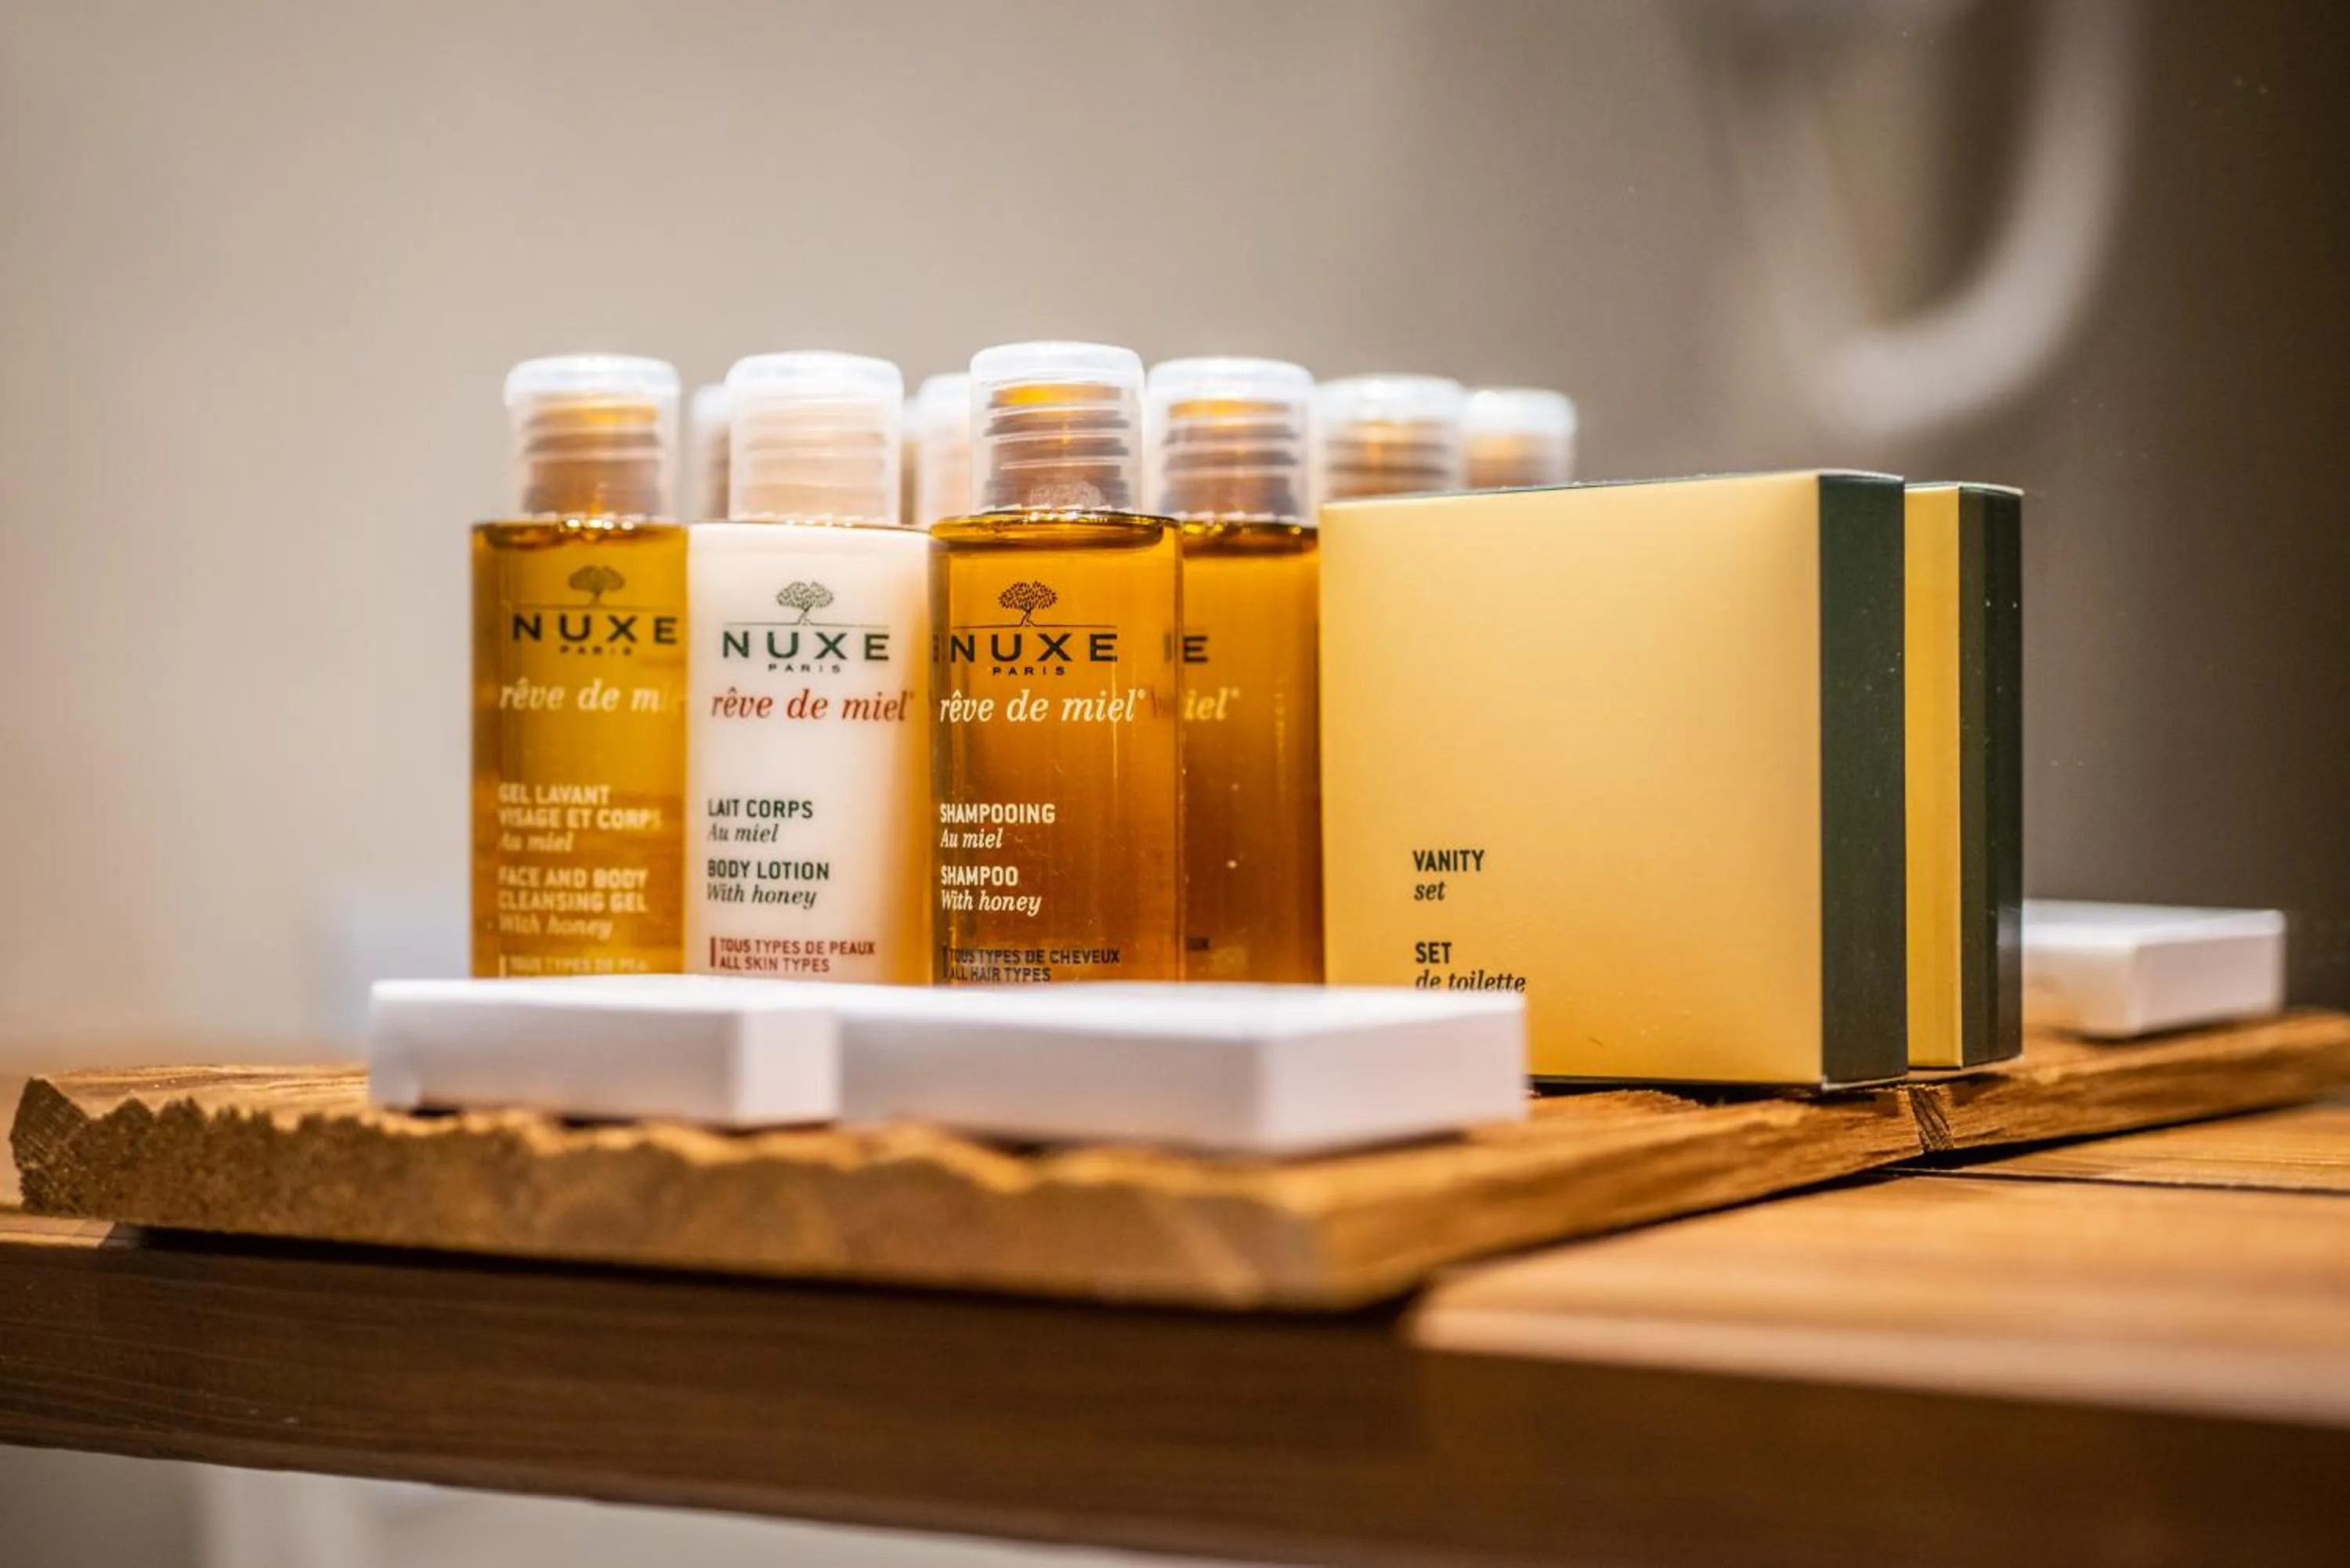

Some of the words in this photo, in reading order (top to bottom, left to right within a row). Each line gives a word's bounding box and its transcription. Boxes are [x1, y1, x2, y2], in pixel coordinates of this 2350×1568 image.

[513, 613, 677, 644] NUXE
[560, 645, 632, 656] PARIS
[723, 630, 889, 660] NUXE
[951, 634, 1118, 663] NUXE
[768, 664, 840, 673] PARIS
[992, 667, 1065, 676] PARIS
[499, 676, 566, 710] rêve
[578, 677, 620, 711] de
[711, 686, 773, 718] rêve
[787, 688, 828, 719] de
[940, 689, 994, 722] rêve
[1007, 689, 1049, 722] de
[498, 783, 530, 804] GEL
[535, 784, 610, 805] LAVANT
[499, 807, 561, 829] VISAGE
[566, 809, 593, 829] ET
[708, 799, 740, 817] LAIT
[747, 800, 813, 818] CORPS
[940, 803, 1056, 824] SHAMPOOING
[498, 833, 522, 851] Au
[527, 831, 574, 852] miel
[707, 823, 728, 842] Au
[735, 823, 779, 843] miel
[940, 828, 958, 848] Au
[962, 827, 1003, 849] miel
[707, 859, 750, 879] BODY
[757, 862, 830, 880] LOTION
[1413, 850, 1484, 872] VANITY
[498, 866, 540, 887] FACE
[544, 868, 587, 888] AND
[592, 869, 649, 890] BODY
[941, 865, 1018, 887] SHAMPOO
[498, 890, 606, 912] CLEANSING
[609, 892, 649, 913] GEL
[707, 883, 745, 903] With
[751, 884, 817, 910] honey
[1413, 880, 1445, 901] set
[941, 889, 973, 911] With
[978, 890, 1042, 917] honey
[499, 913, 540, 934] With
[547, 915, 613, 940] honey
[719, 938, 751, 953] TOUS
[756, 940, 801, 955] TYPES
[806, 940, 825, 955] DE
[830, 941, 876, 956] PEAUX
[949, 948, 975, 963] TOUS
[978, 948, 1021, 964] TYPES
[1025, 950, 1044, 963] DE
[1050, 949, 1120, 964] CHEVEUX
[1415, 941, 1452, 964] SET
[719, 956, 740, 970] ALL
[746, 957, 778, 971] SKIN
[783, 958, 830, 973] TYPES
[971, 967, 1000, 982] HAIR
[1004, 967, 1052, 982] TYPES
[1415, 969, 1441, 990] de
[1448, 970, 1527, 993] toilette
